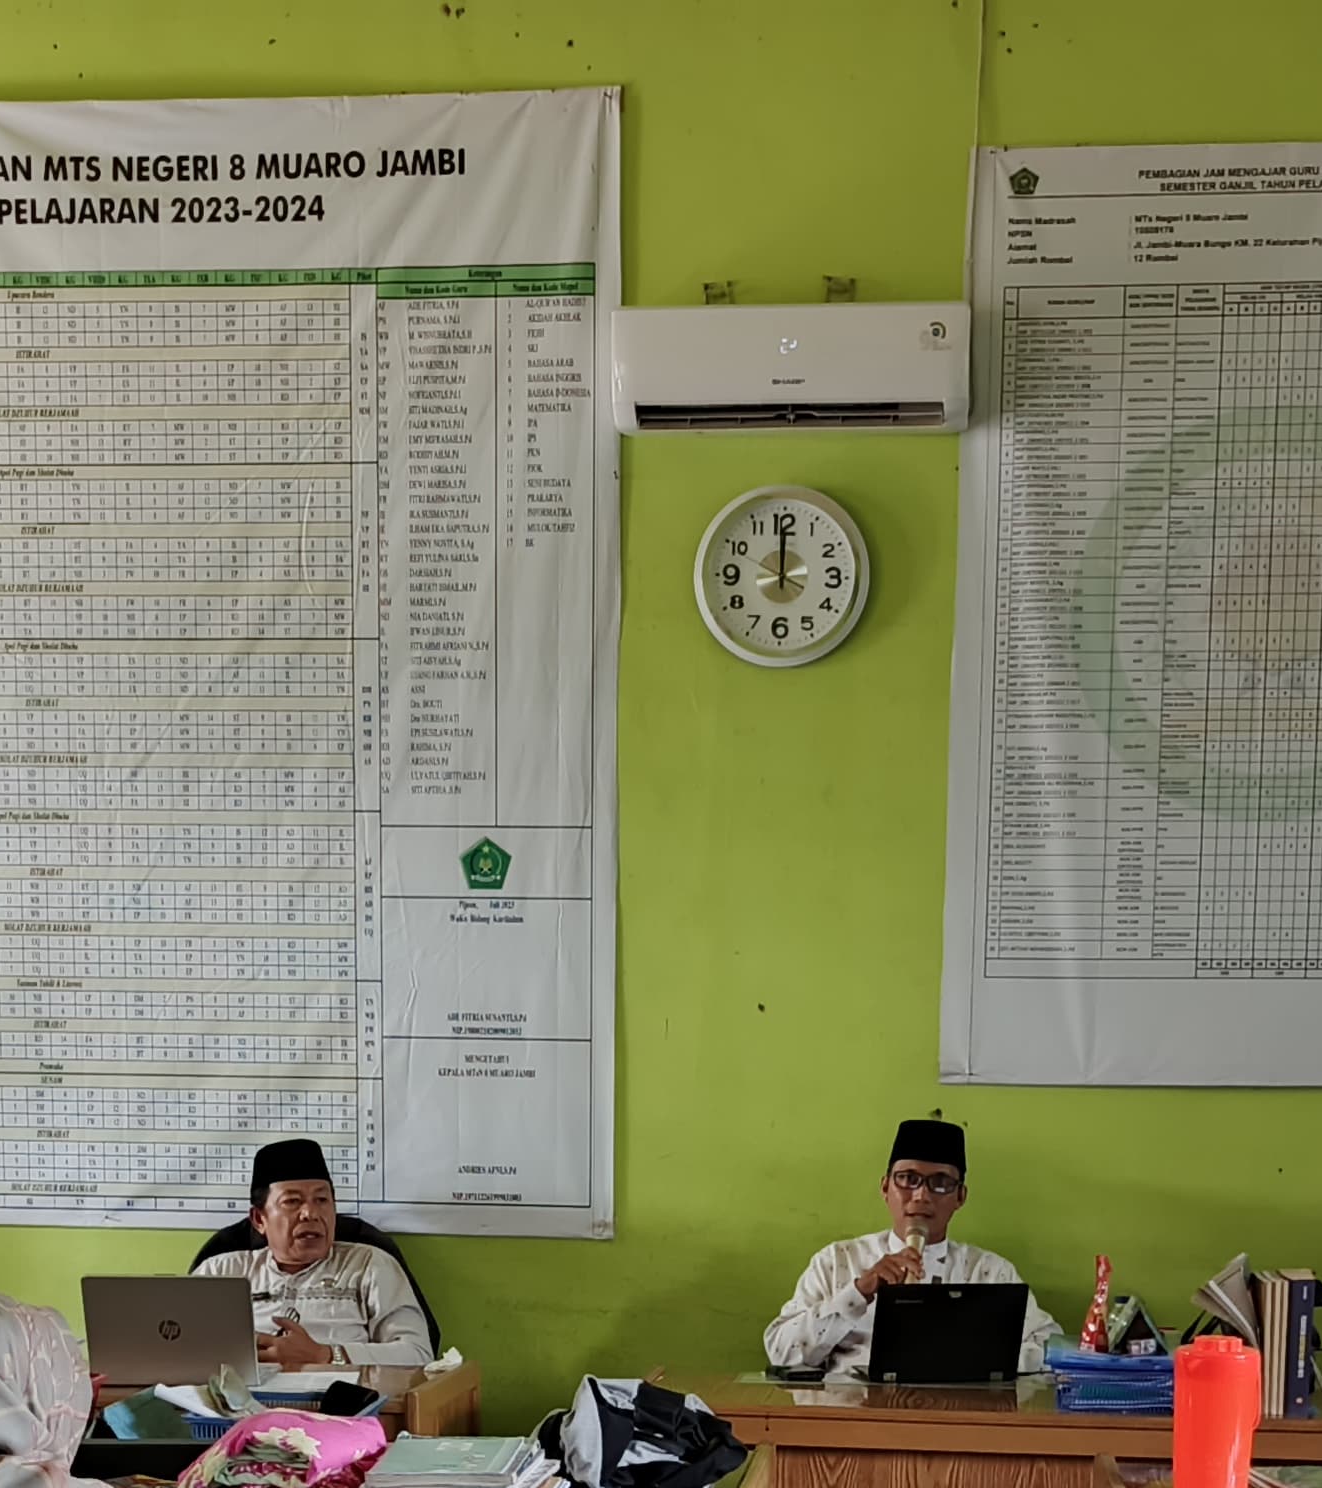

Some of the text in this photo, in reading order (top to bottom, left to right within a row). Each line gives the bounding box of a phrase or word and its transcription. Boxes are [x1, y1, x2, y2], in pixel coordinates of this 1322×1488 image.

[43, 155, 102, 183] MTS
[111, 154, 219, 182] NEGERI
[228, 153, 246, 181] 8
[255, 150, 366, 180] MUARO
[375, 147, 467, 177] JAMBI
[1138, 168, 1201, 180] PEMBAGIAN
[1204, 167, 1225, 179] JAM
[1228, 166, 1286, 178] MENGAJAR
[1289, 165, 1319, 177] GURU
[1159, 181, 1216, 193] SEMESTER
[1219, 180, 1257, 191] GANJIL
[1261, 179, 1295, 190] TAHUN
[170, 194, 325, 223] 2023-2024
[752, 520, 764, 536] 11
[773, 513, 796, 536] 12
[731, 540, 749, 557] 10
[821, 542, 835, 559] 2
[721, 563, 741, 587] 9
[824, 566, 843, 590] 3
[729, 594, 745, 610] 8
[818, 597, 834, 613] 4
[747, 614, 761, 630] 7
[770, 616, 790, 640] 6
[800, 616, 815, 631] 5
